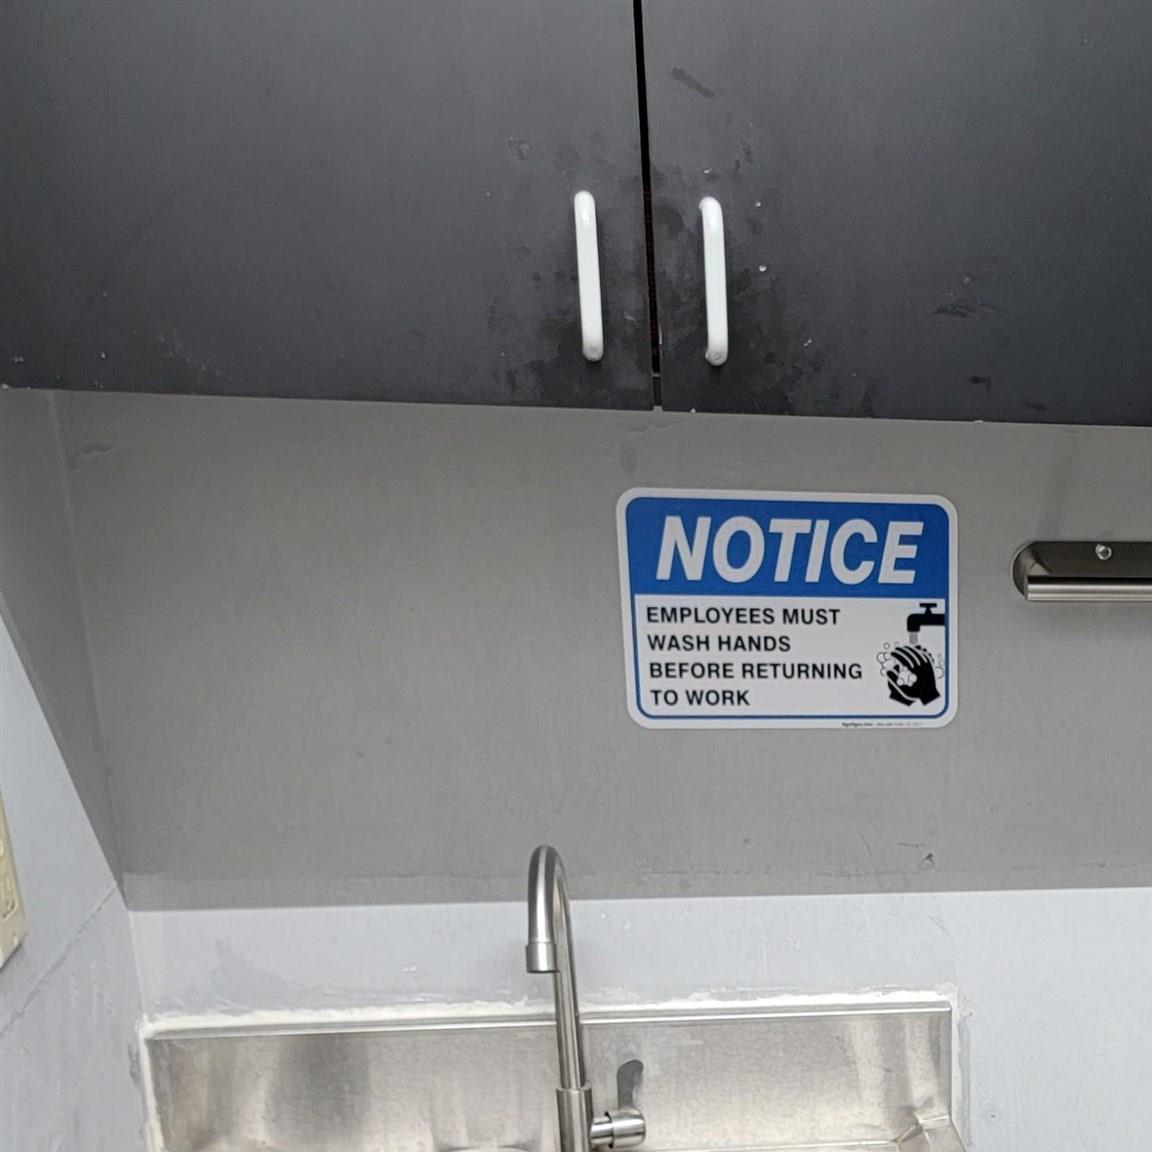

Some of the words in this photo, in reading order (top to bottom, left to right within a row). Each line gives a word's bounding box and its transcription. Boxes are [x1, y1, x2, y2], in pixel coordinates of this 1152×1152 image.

[656, 515, 924, 585] NOTICE
[646, 606, 775, 624] EMPLOYEES
[782, 608, 841, 626] MUST
[647, 634, 710, 652] WASH
[717, 635, 791, 653] HANDS
[649, 662, 735, 679] BEFORE
[741, 662, 863, 680] RETURNING
[650, 689, 679, 706] TO
[685, 689, 751, 706] WORK
